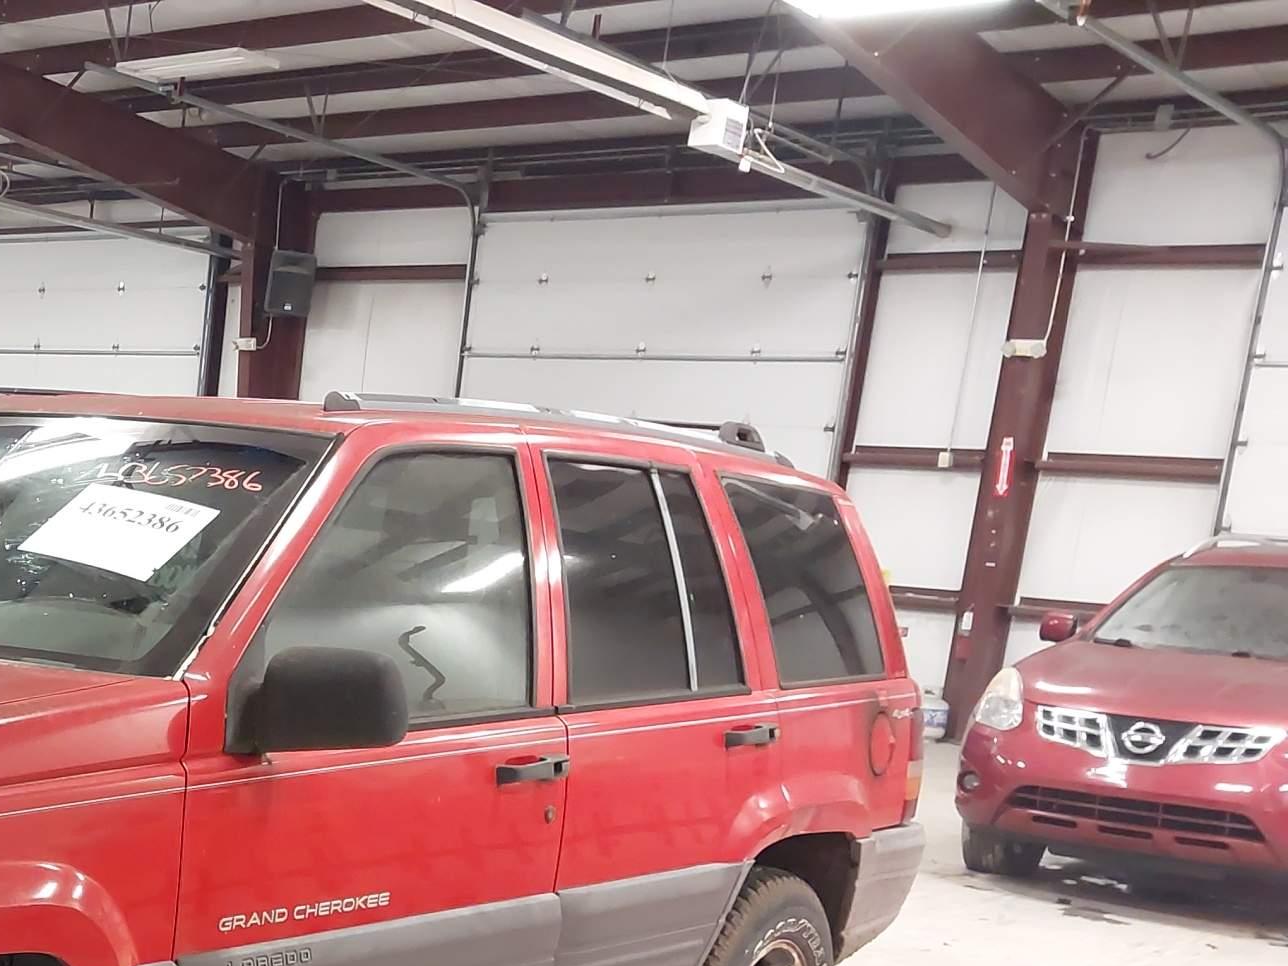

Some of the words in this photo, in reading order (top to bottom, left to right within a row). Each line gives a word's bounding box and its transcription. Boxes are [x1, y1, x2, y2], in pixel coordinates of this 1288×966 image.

[79, 501, 185, 533] 43652386
[218, 908, 288, 932] GRAND
[293, 892, 391, 920] CHEROKEE
